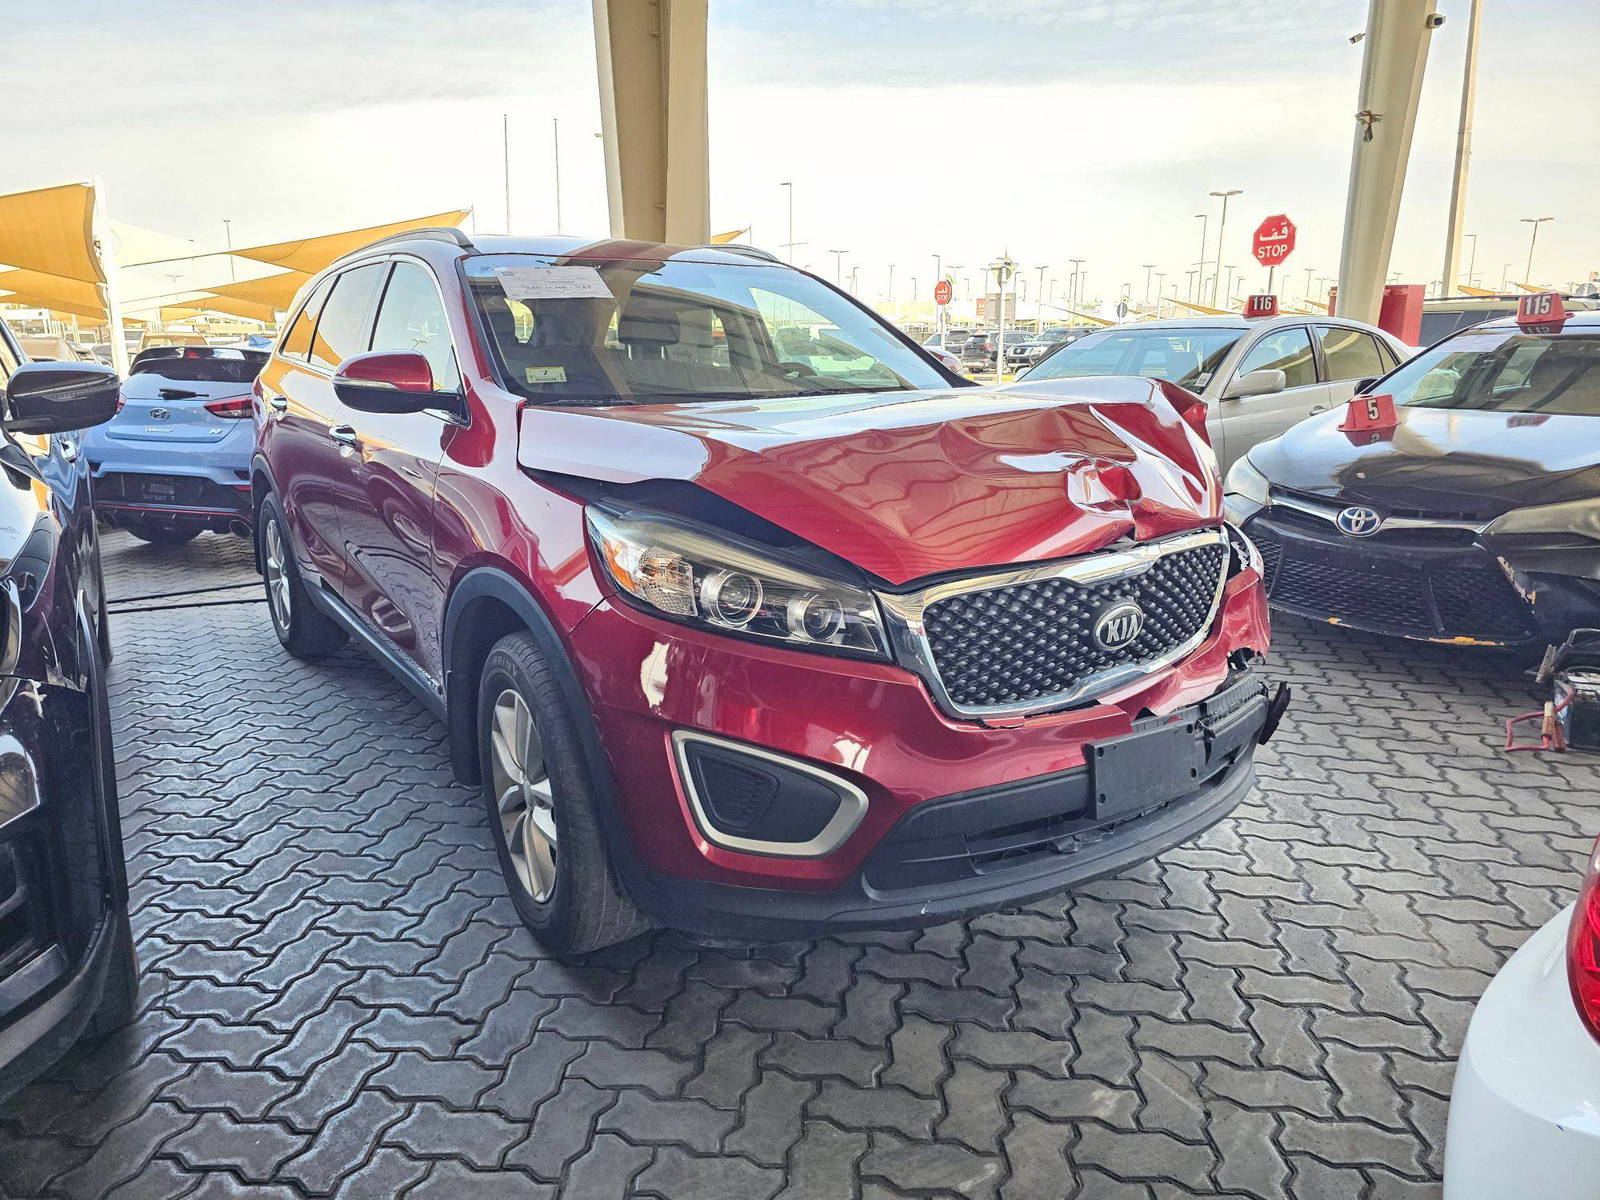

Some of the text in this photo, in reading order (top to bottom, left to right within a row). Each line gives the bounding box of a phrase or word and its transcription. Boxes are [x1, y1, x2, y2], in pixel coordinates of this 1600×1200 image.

[1260, 222, 1288, 241] قف
[1258, 244, 1288, 258] STOP
[1253, 296, 1272, 310] 116
[1525, 295, 1551, 315] 115
[1367, 399, 1379, 420] 5
[1106, 614, 1139, 643] KIA
